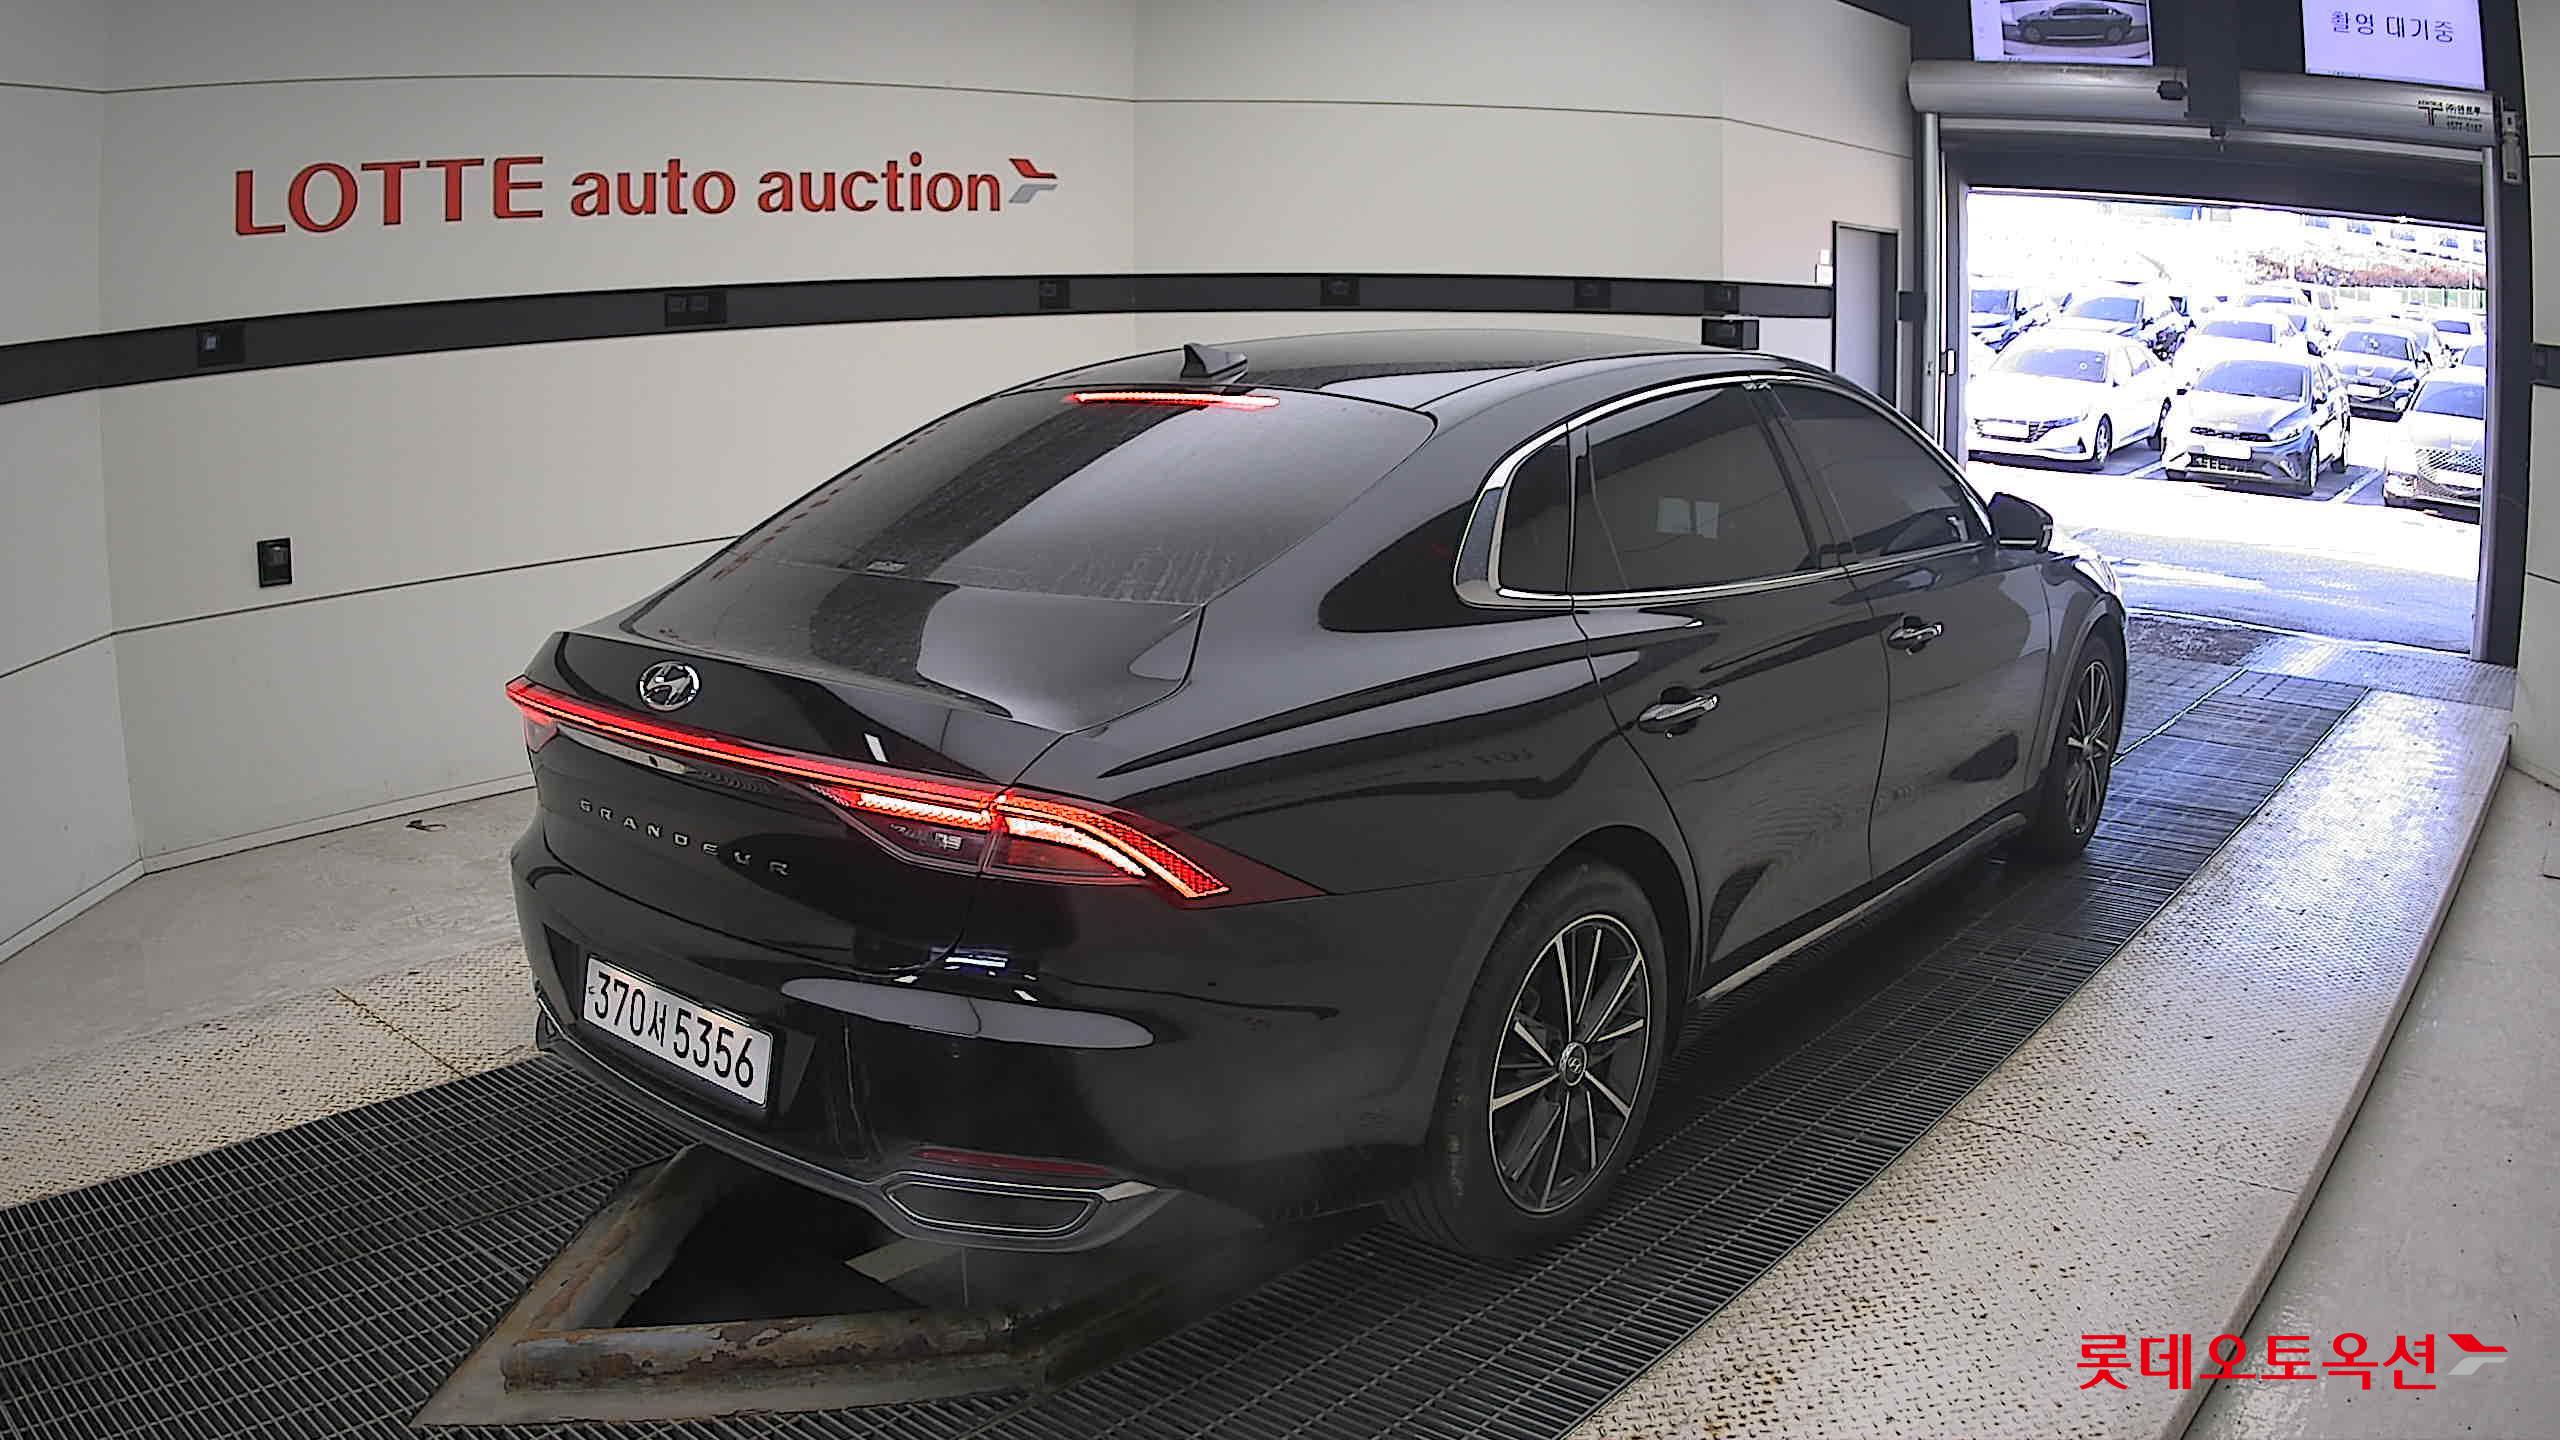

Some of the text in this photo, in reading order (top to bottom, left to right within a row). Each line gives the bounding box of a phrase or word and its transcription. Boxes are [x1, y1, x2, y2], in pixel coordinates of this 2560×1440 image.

[2385, 15, 2455, 43] 대기중
[235, 152, 1001, 235] LOTTE auto auction
[579, 799, 789, 877] GRANDEUR
